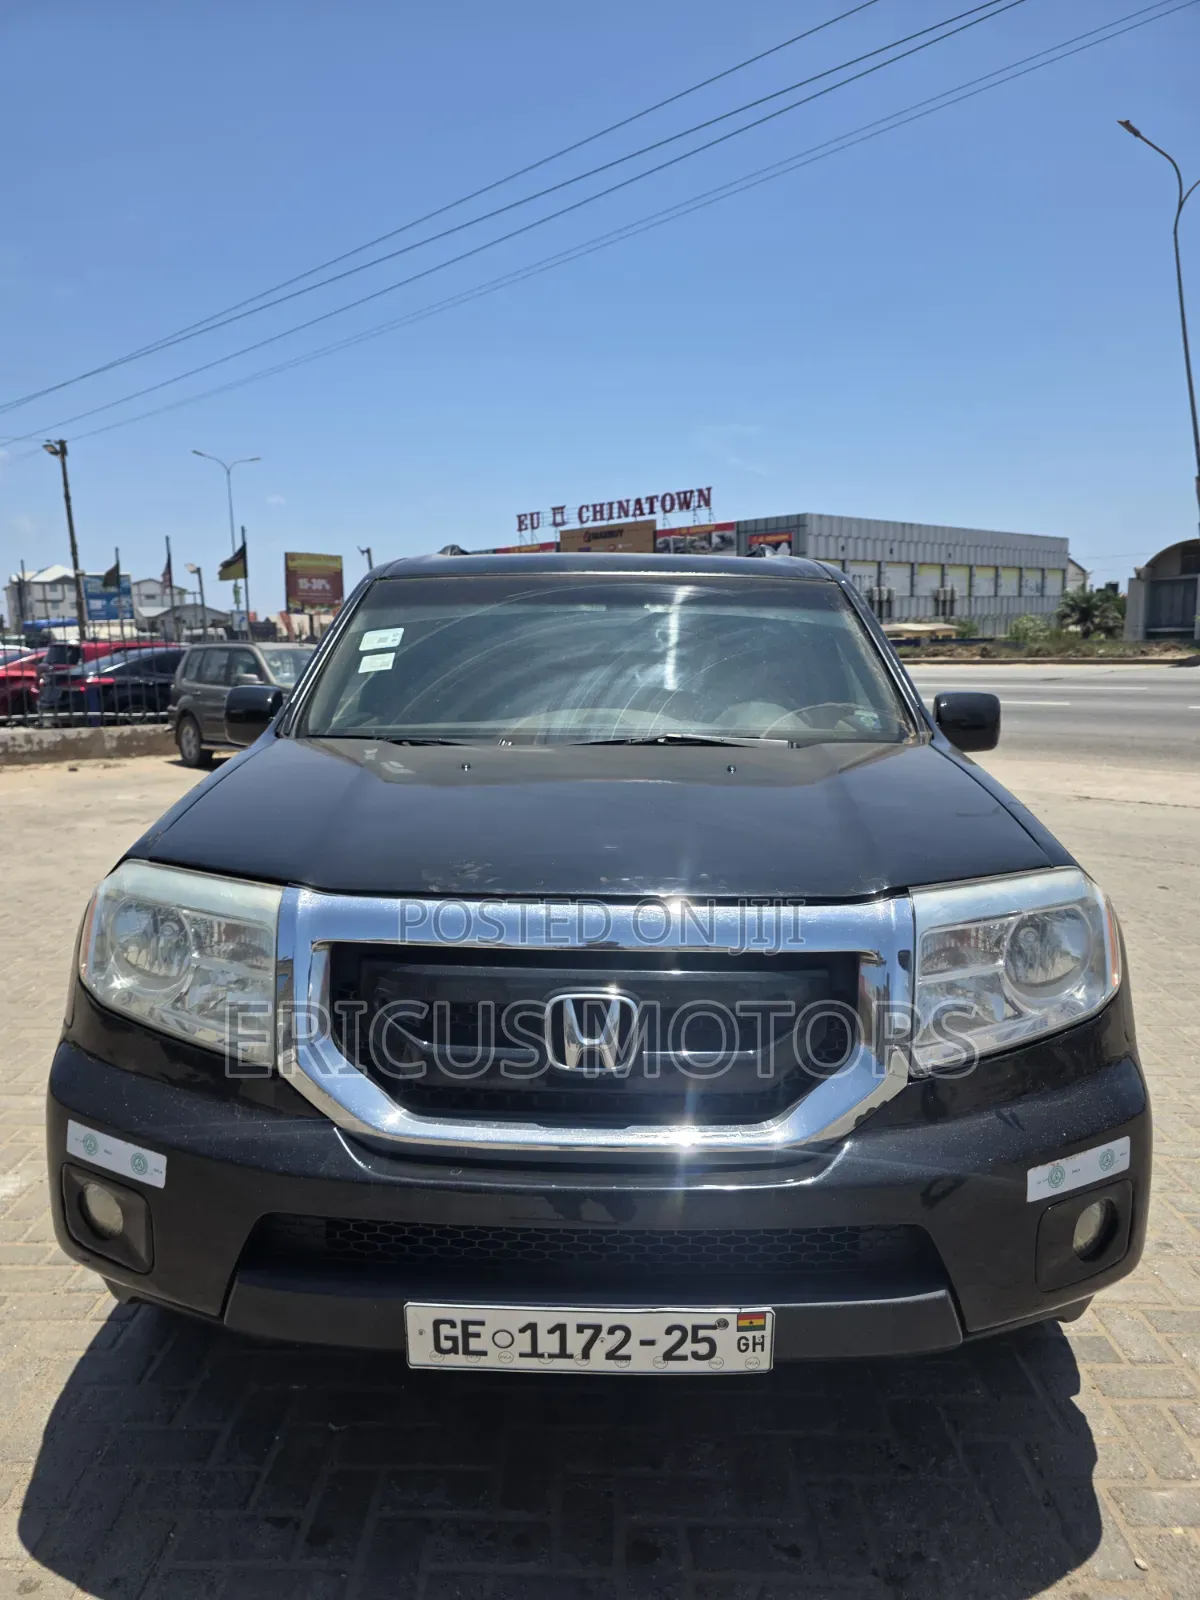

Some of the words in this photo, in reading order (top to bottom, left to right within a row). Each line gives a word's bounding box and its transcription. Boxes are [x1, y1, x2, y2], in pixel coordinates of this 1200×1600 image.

[516, 511, 542, 532] EU
[577, 487, 713, 524] CHINATOWN
[432, 1318, 488, 1356] GE
[518, 1322, 718, 1361] 1172-25
[737, 1335, 765, 1353] GH
